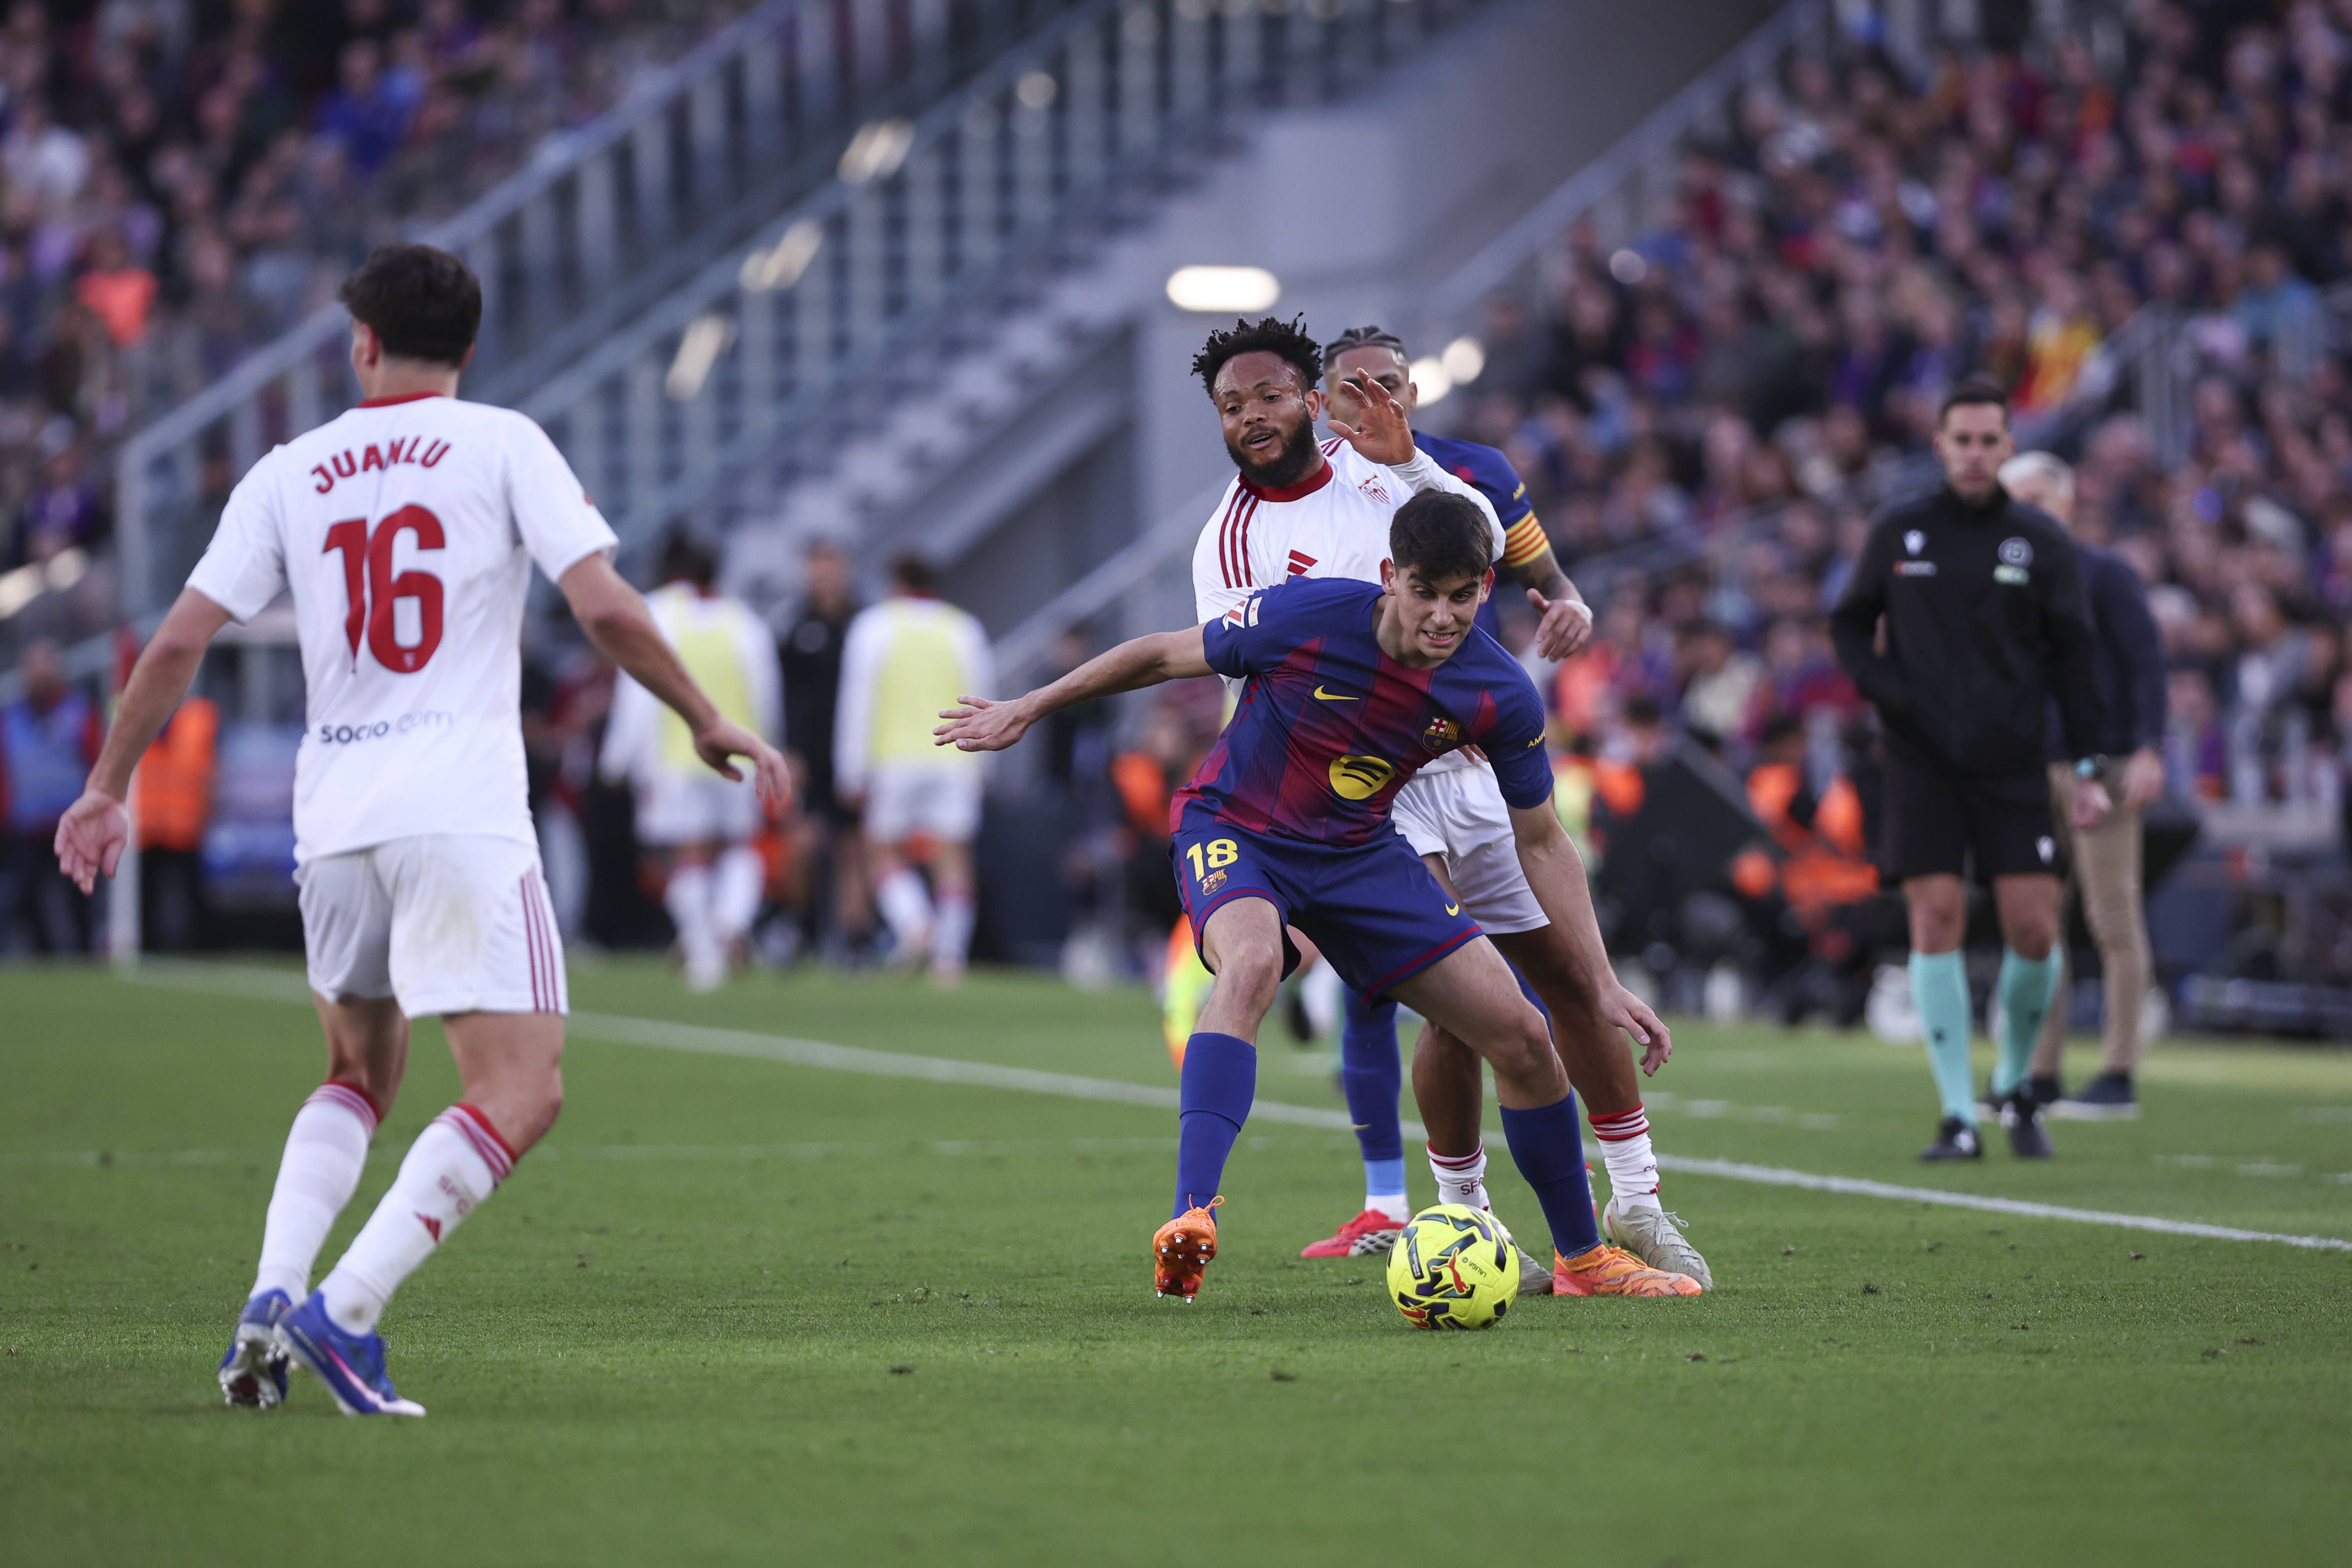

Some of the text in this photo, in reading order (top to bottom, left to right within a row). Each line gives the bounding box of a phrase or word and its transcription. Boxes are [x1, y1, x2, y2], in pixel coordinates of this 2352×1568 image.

[312, 436, 450, 495] JUANLU
[323, 503, 446, 674] 16
[1186, 838, 1238, 882] 18
[1469, 1260, 1487, 1279] LALIGA
